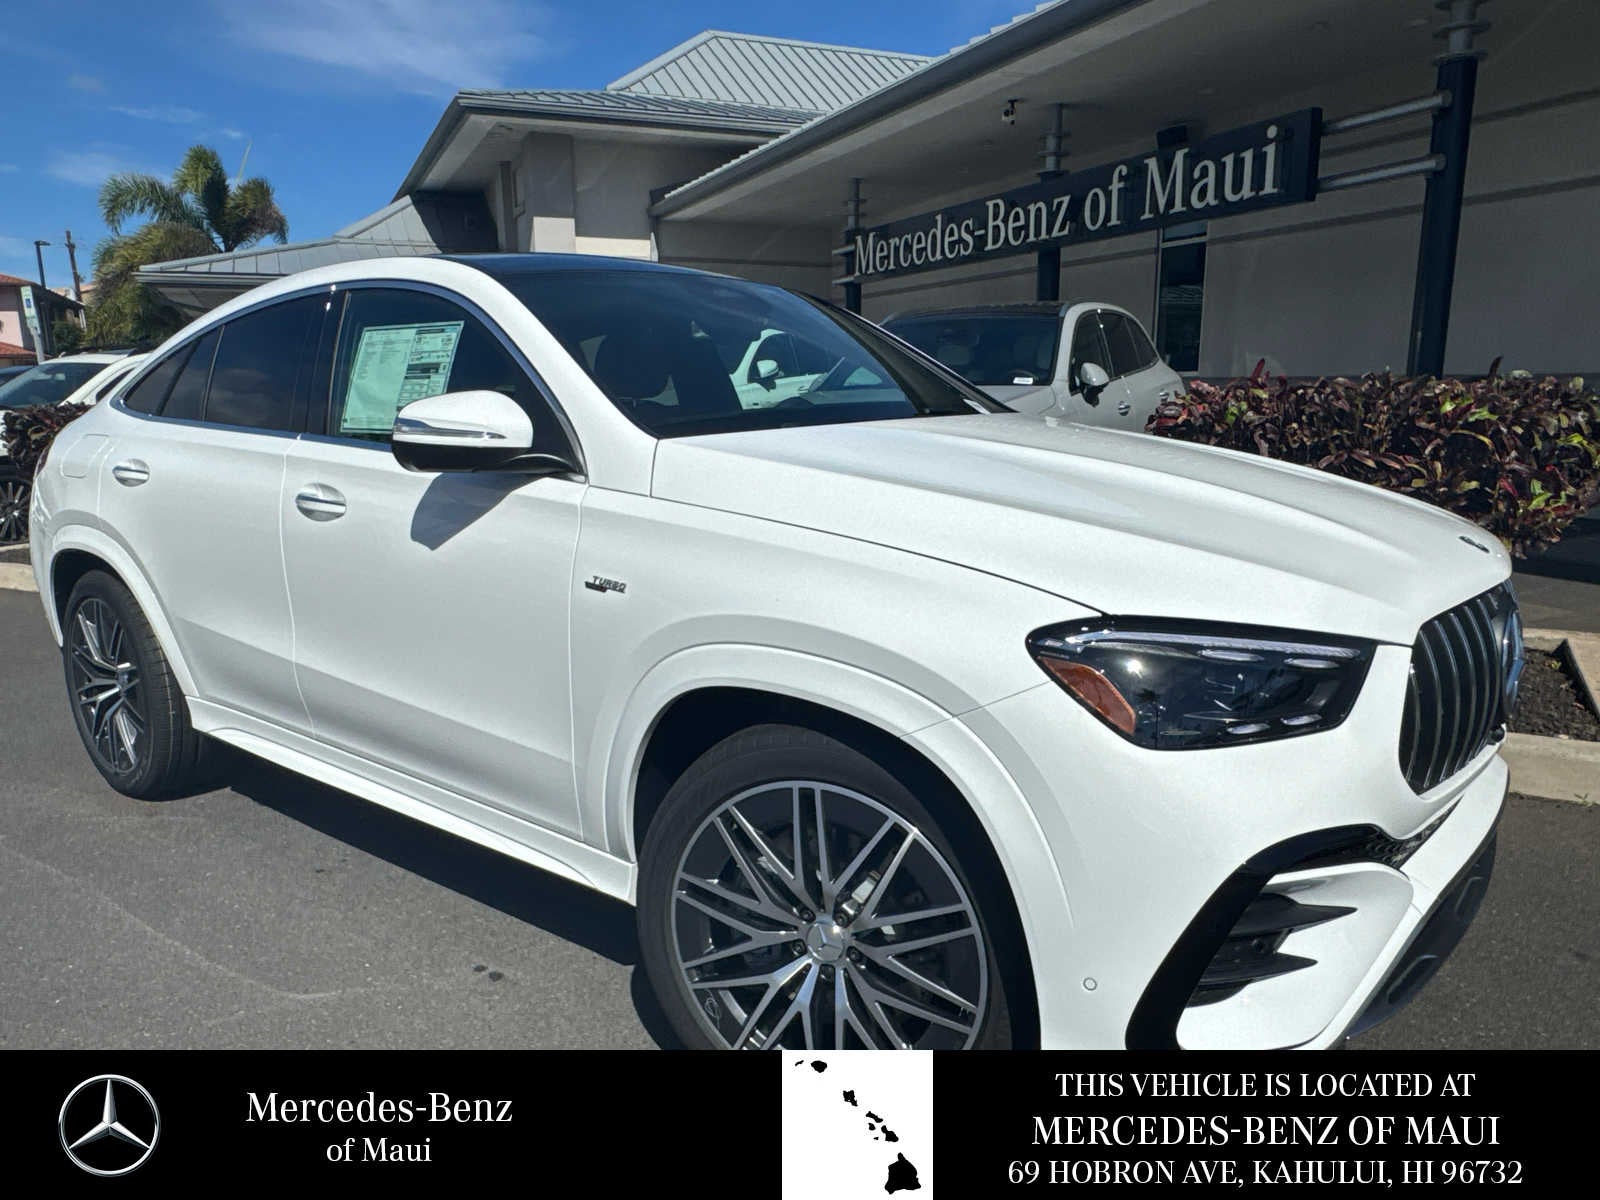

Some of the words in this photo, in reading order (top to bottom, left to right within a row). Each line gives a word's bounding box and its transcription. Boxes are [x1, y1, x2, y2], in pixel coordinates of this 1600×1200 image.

[854, 194, 1070, 276] Mercedes-Benz
[1084, 165, 1127, 231] of
[1140, 125, 1278, 221] Maui
[592, 575, 627, 594] TURBO
